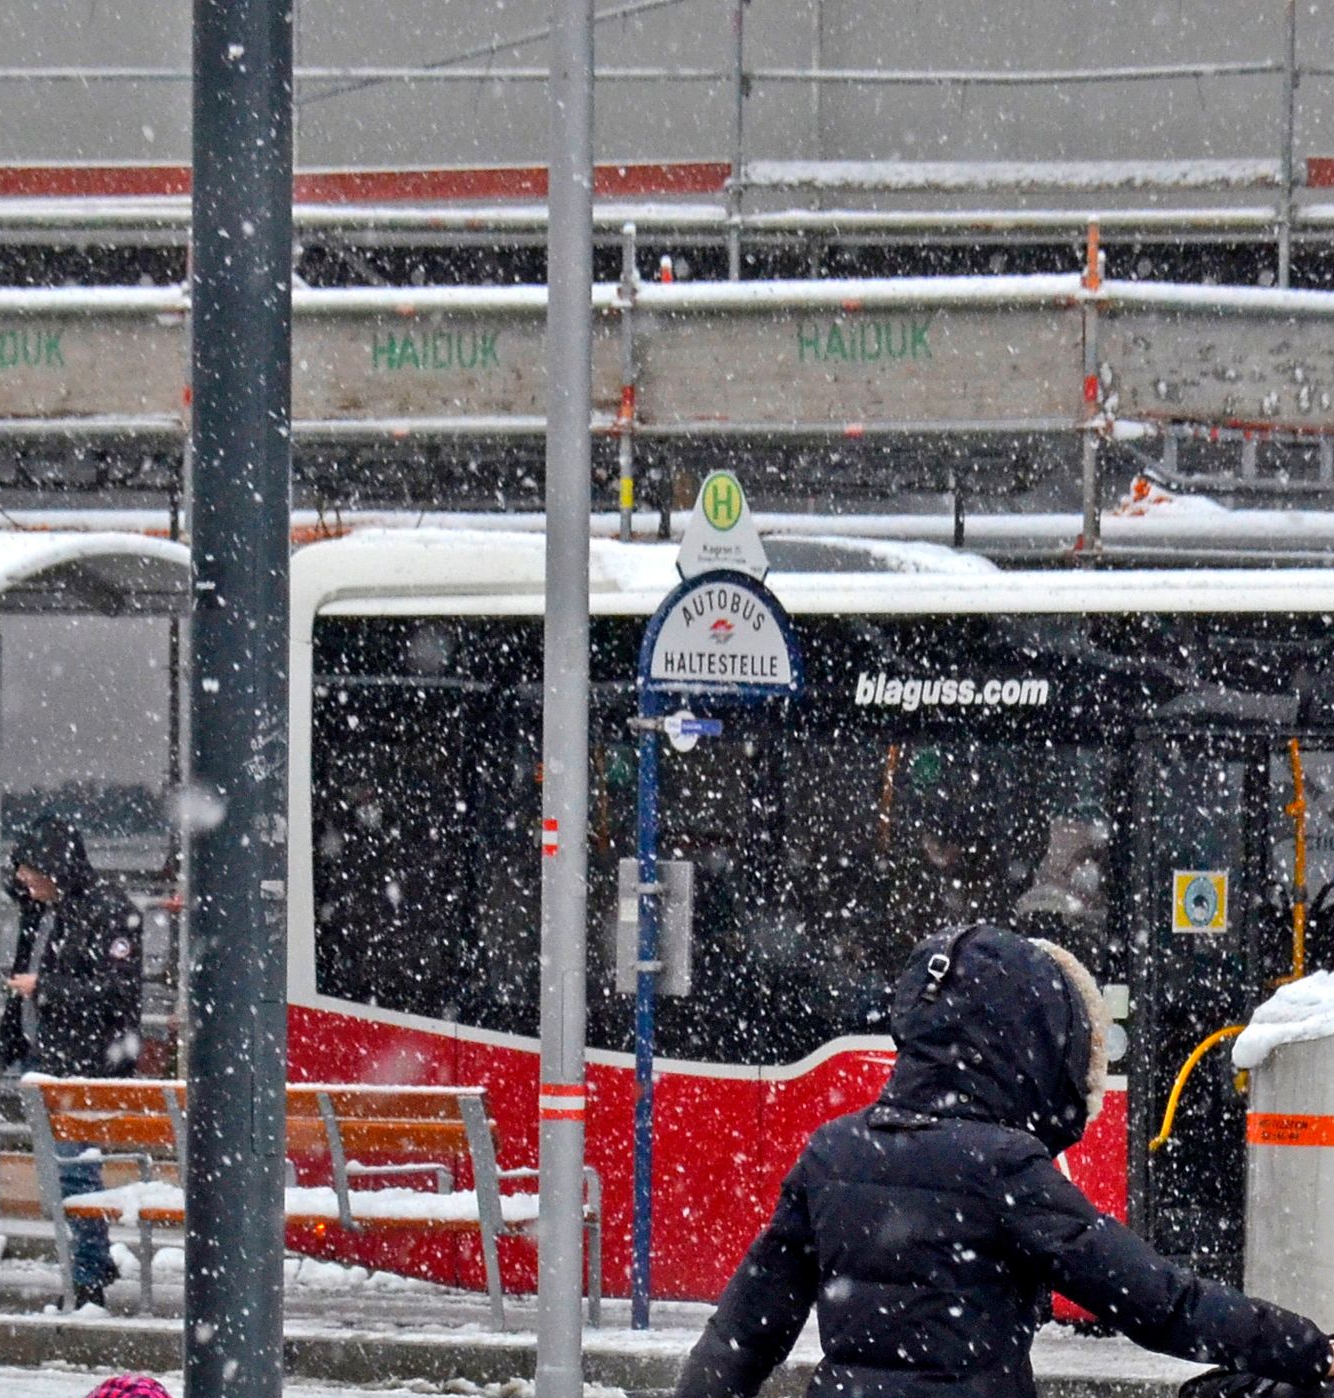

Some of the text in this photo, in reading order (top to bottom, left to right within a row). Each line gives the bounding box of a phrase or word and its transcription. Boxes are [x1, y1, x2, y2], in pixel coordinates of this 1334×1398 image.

[372, 330, 501, 369] HAIDUK
[796, 319, 933, 362] HAIDUK
[712, 484, 733, 520] H
[681, 589, 766, 631] AUTOBUS
[664, 651, 779, 677] HALTESTELLE
[854, 671, 1050, 712] blaguss.com
